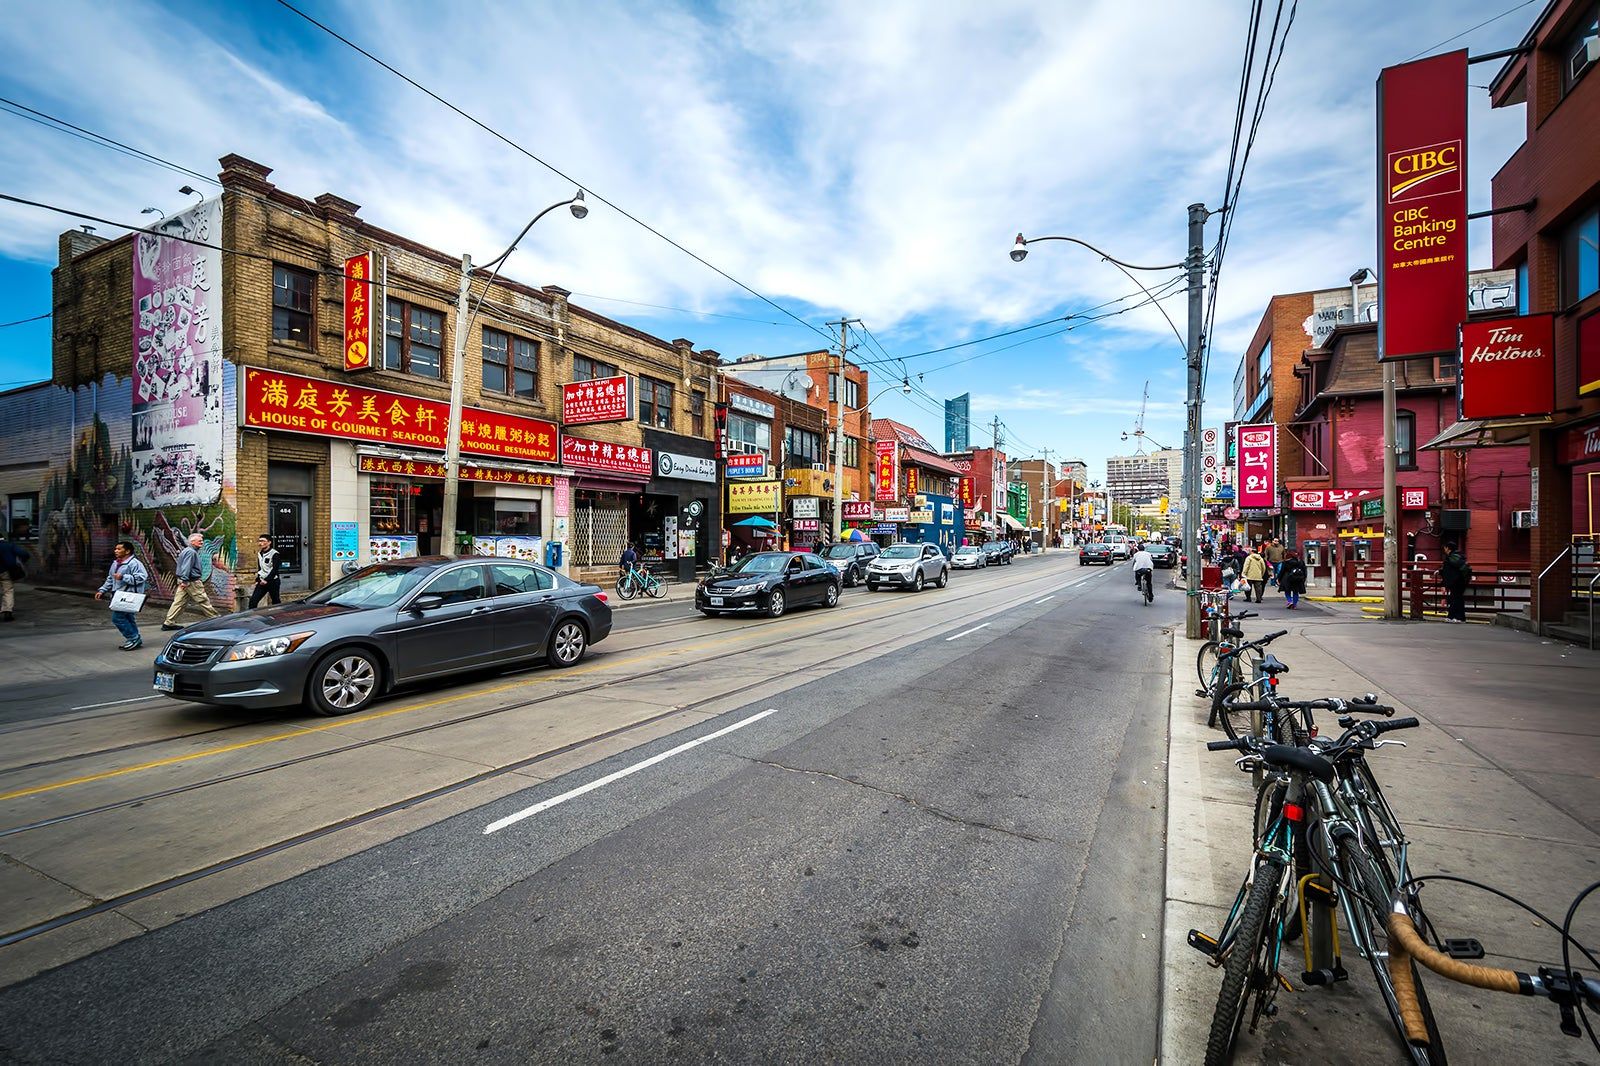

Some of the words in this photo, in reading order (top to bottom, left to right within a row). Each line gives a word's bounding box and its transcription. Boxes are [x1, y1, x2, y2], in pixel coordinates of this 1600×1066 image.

[1393, 146, 1456, 175] CIBC
[1393, 206, 1429, 223] CIBC
[1393, 218, 1457, 238] Banking
[1393, 234, 1447, 251] Centre
[1487, 326, 1524, 345] Tim
[1469, 345, 1542, 364] Hortons
[261, 379, 437, 432] 滿庭芳美食軒
[261, 411, 306, 427] HOUSE
[310, 417, 327, 430] OF
[331, 421, 388, 437] GOURMET
[392, 430, 441, 445] SEAFOOD,
[467, 441, 501, 452] NOODLE
[504, 445, 550, 458] RESTAURANT
[673, 462, 685, 474] Easy
[685, 464, 698, 473] Drink
[699, 466, 709, 477] Easy
[1244, 451, 1269, 494] 낙원
